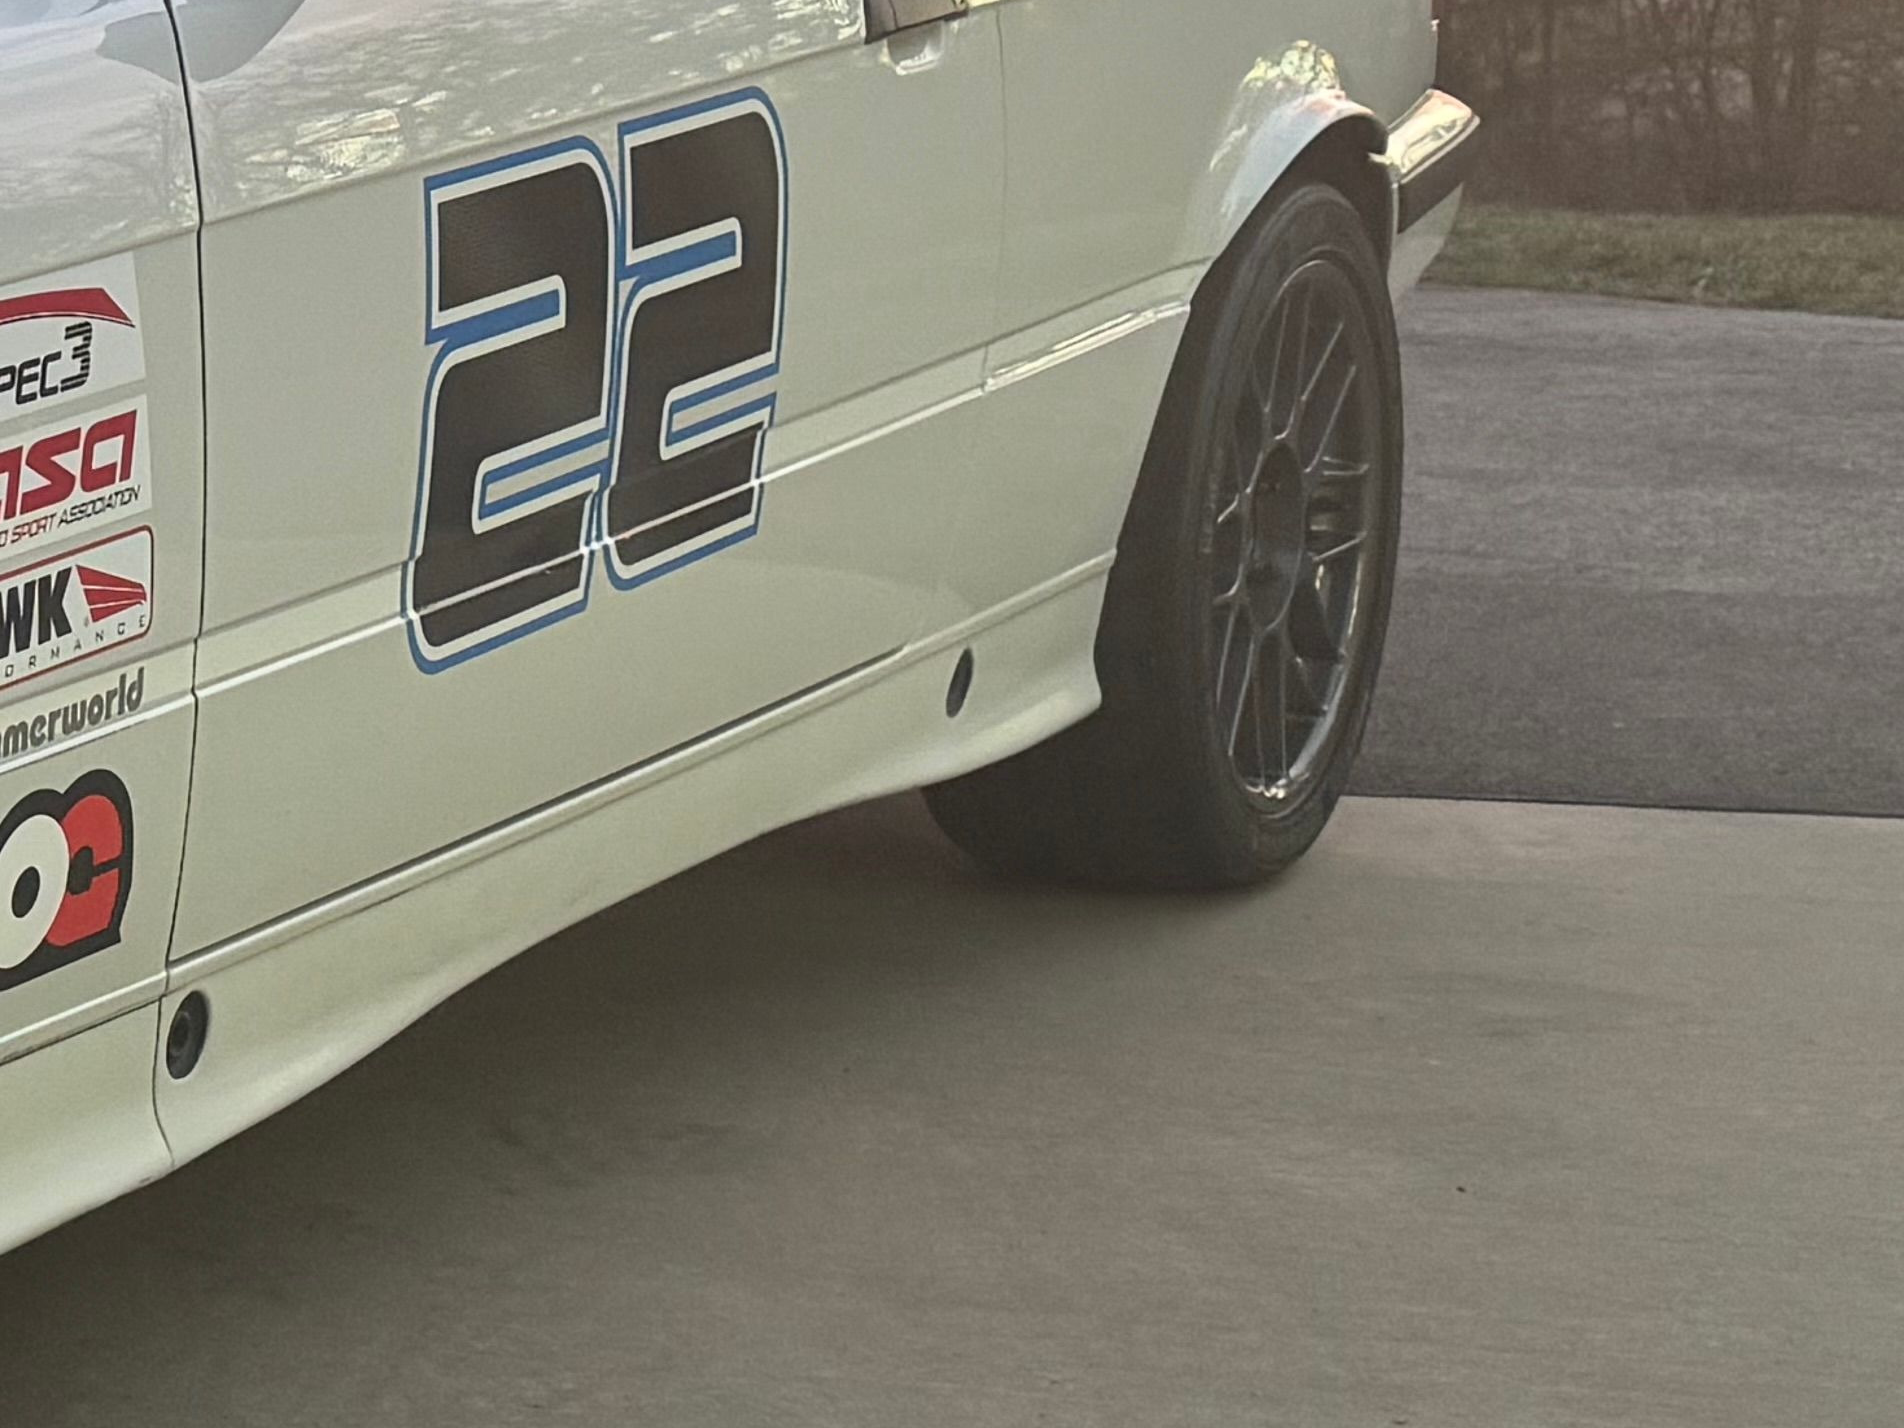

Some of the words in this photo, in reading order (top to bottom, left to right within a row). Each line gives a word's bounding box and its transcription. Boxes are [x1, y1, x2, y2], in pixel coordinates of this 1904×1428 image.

[10, 513, 57, 544] SPORT
[58, 485, 141, 523] ASSOCIATION
[400, 86, 789, 675] 22
